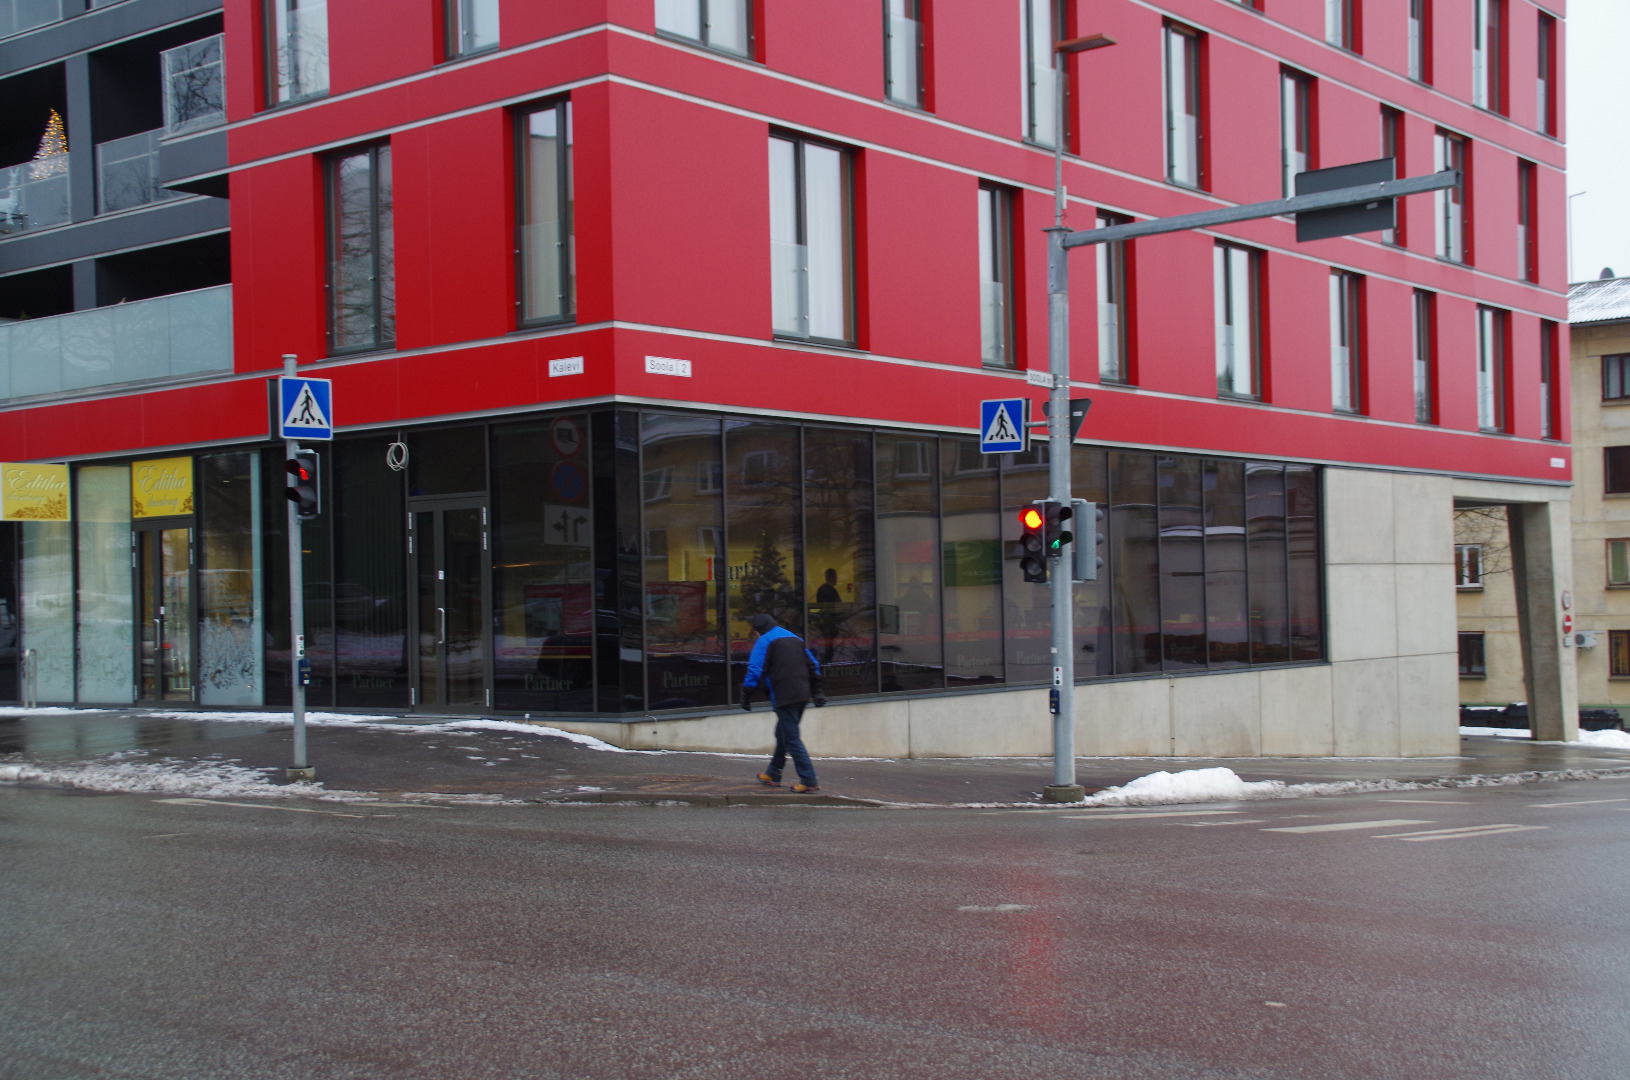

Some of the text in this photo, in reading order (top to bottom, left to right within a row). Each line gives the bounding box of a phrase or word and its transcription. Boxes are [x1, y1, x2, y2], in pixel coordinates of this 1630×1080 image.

[553, 361, 580, 373] Kalevi
[649, 359, 688, 373] Soola 2
[1029, 373, 1046, 383] SOOLA
[5, 469, 66, 490] Editha
[137, 465, 187, 495] Editha
[524, 673, 573, 690] Partner
[663, 671, 711, 688] Partner
